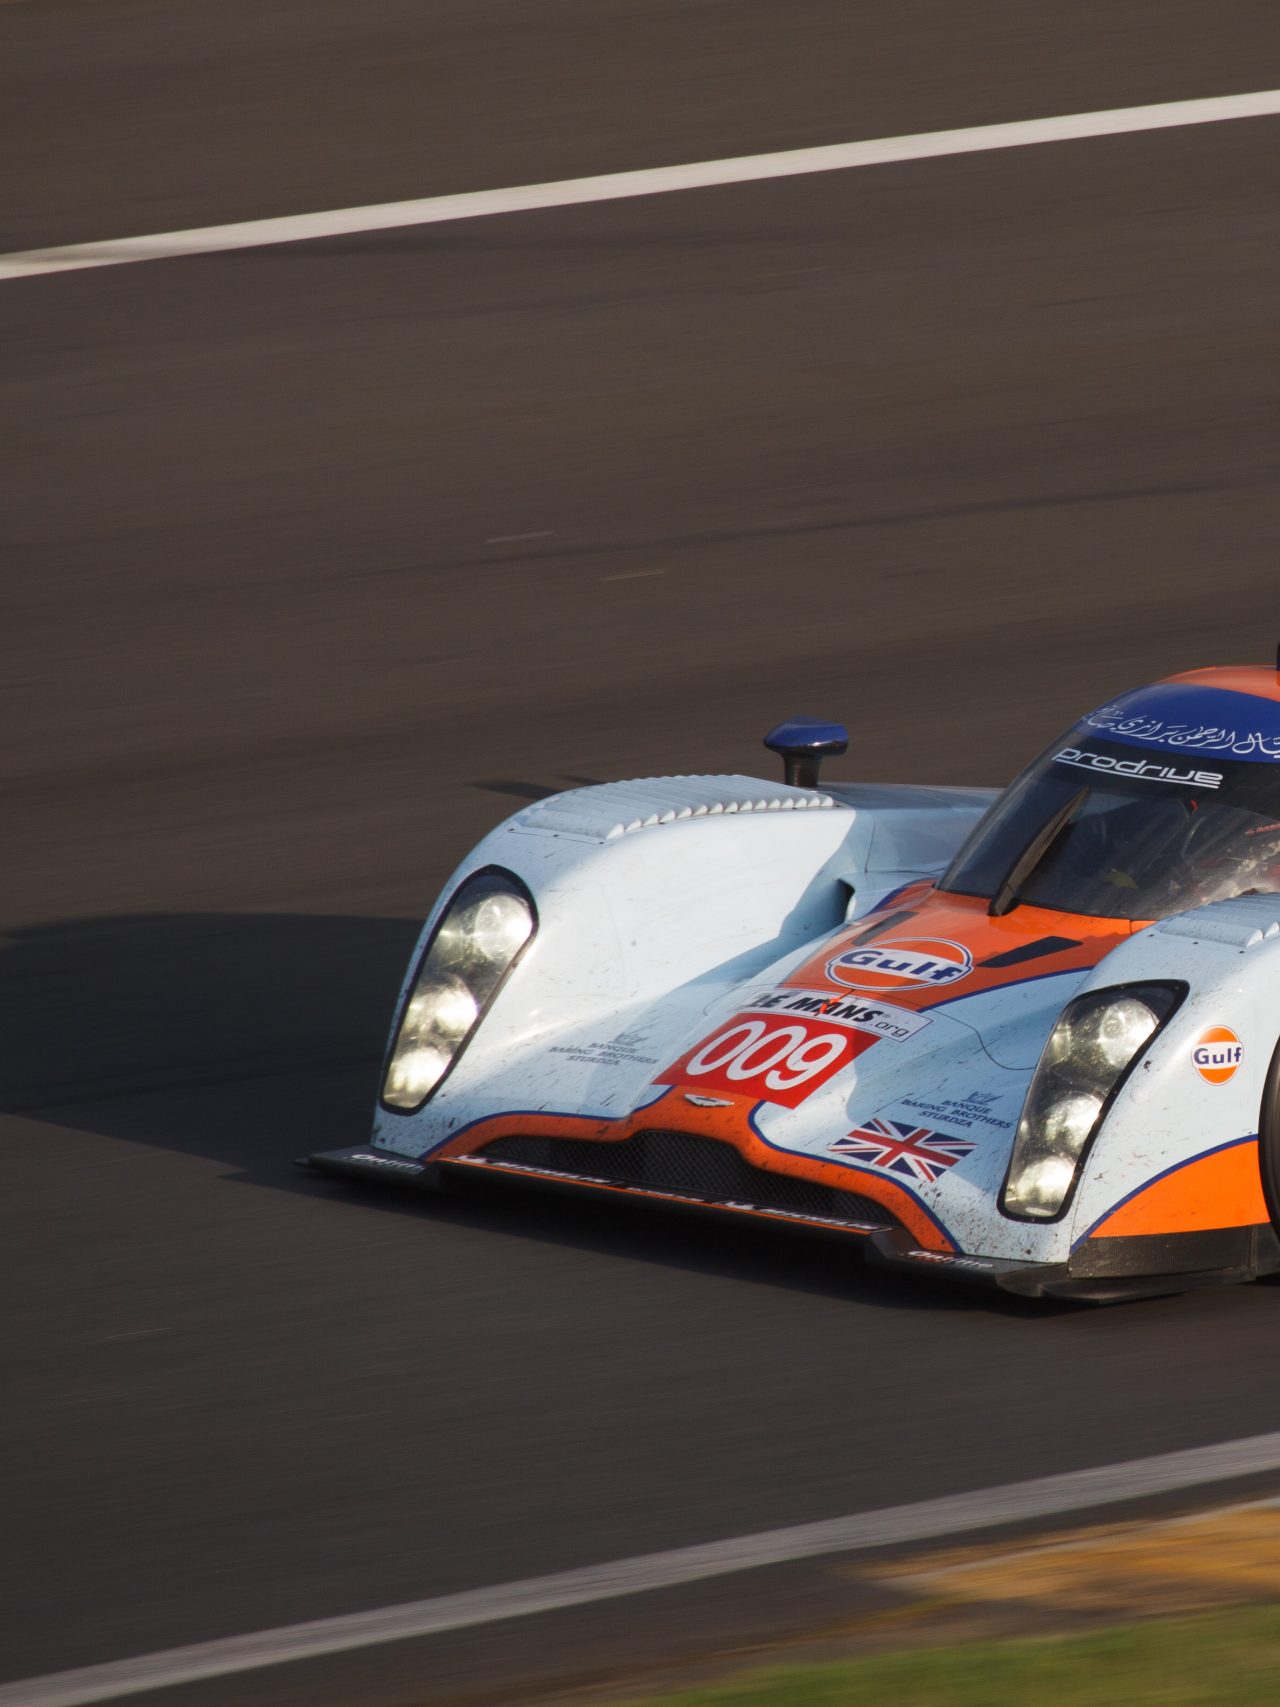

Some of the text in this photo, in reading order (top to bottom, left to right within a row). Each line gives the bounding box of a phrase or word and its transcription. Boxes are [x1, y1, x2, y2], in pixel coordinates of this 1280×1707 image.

[1053, 747, 1224, 784] prodrive
[840, 950, 963, 980] Gulf
[686, 1020, 847, 1091] 009
[1193, 1046, 1242, 1066] Gulf
[900, 1099, 1014, 1129] BARING BROTHERS
[918, 1110, 974, 1128] STURDZA
[941, 1100, 993, 1115] BANQUE
